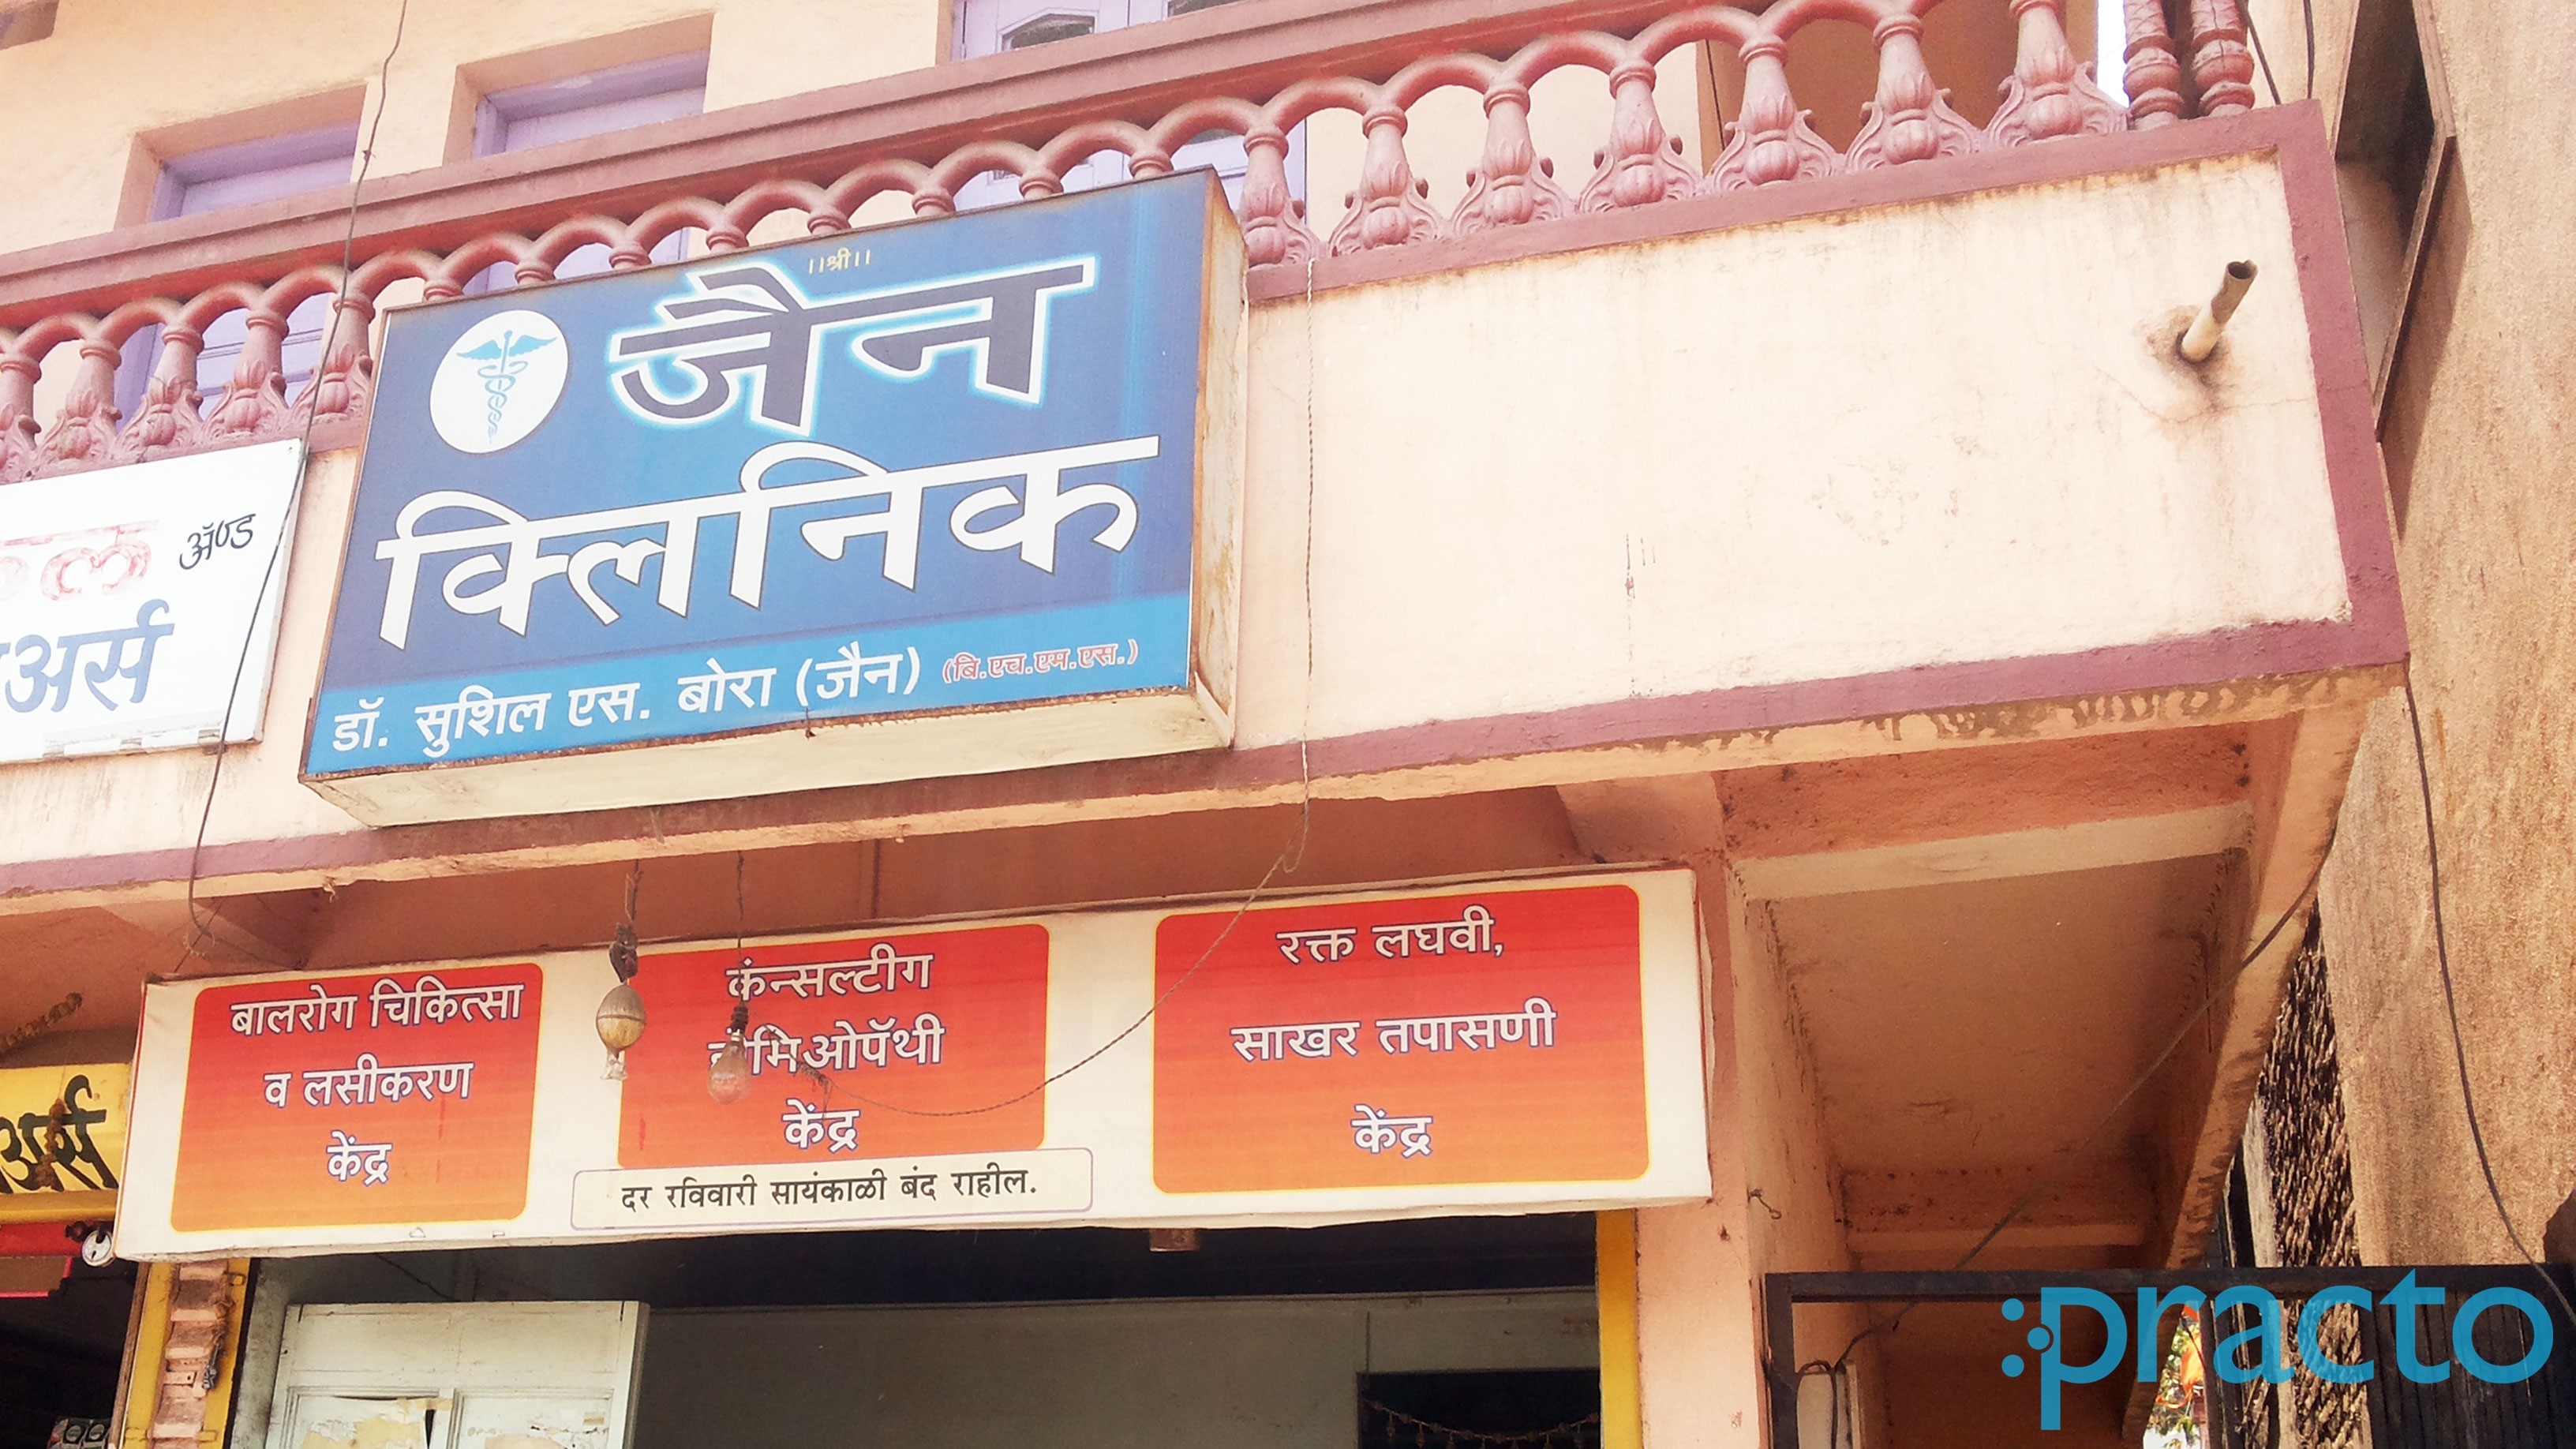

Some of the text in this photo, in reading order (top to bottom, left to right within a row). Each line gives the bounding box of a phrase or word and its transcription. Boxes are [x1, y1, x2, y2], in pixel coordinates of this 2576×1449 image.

[610, 256, 1096, 438] जैन
[375, 433, 1160, 650] क्लिनिक
[0, 598, 175, 713] अर्स
[332, 696, 389, 752] डॉ.
[414, 684, 552, 758] सुशिल
[567, 681, 650, 728] एस.
[676, 657, 777, 713] बोरा
[795, 641, 921, 706] (जैन)
[1276, 903, 1505, 965] रक्त लघवी,
[230, 975, 526, 1036] बालरोग चिकित्सा
[1230, 996, 1558, 1063] साखर तपासणी
[263, 1052, 474, 1107] व लसीकरण
[0, 1073, 120, 1193] अर्स
[781, 1098, 862, 1154] केंद्र
[1350, 1103, 1434, 1160] केंद्र
[325, 1129, 393, 1186] केंद्र
[621, 1161, 1037, 1213] दर रविवारी सायंकाळी बंद राहील.
